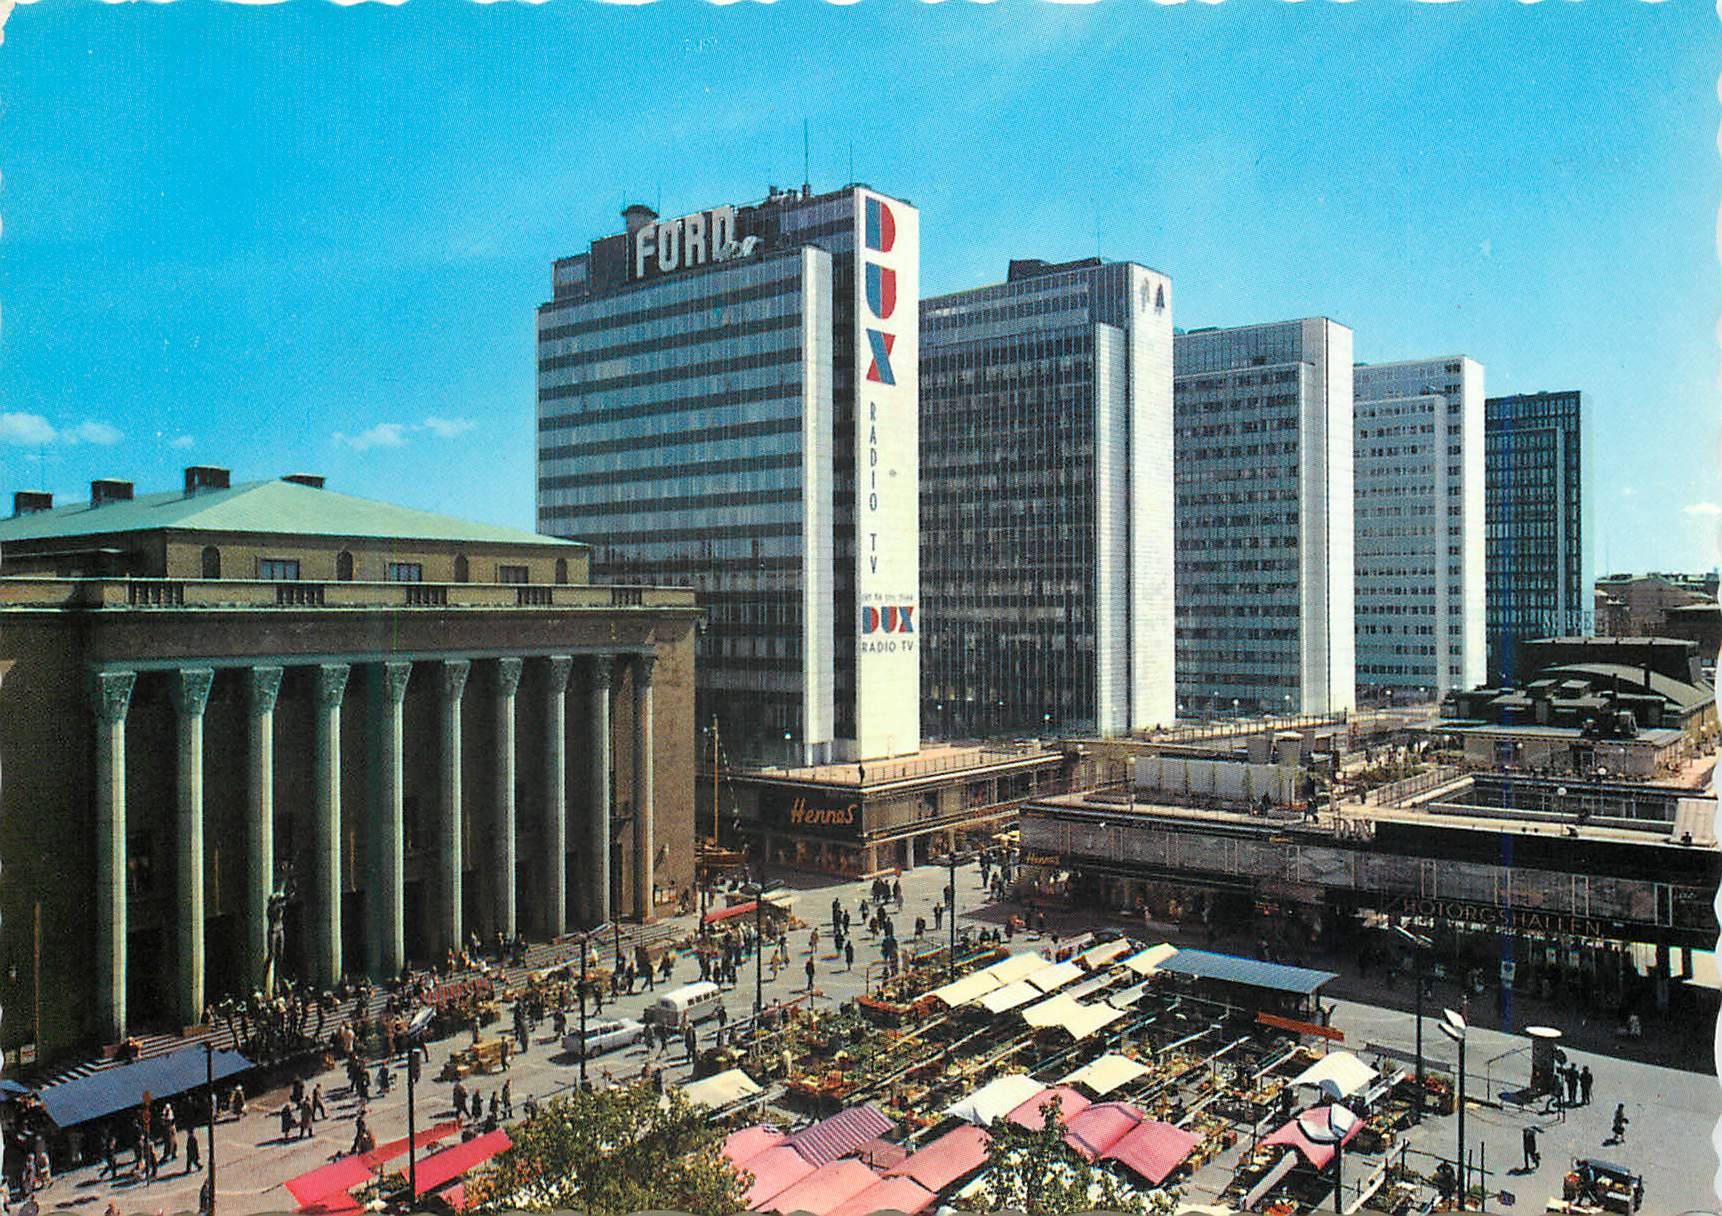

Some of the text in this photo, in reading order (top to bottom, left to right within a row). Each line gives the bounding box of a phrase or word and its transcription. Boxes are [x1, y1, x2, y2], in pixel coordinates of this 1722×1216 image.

[636, 205, 735, 278] FORD
[865, 196, 896, 386] DUX
[869, 401, 877, 574] RADIO TV
[862, 606, 914, 634] DUX
[862, 640, 914, 653] RADIO TV
